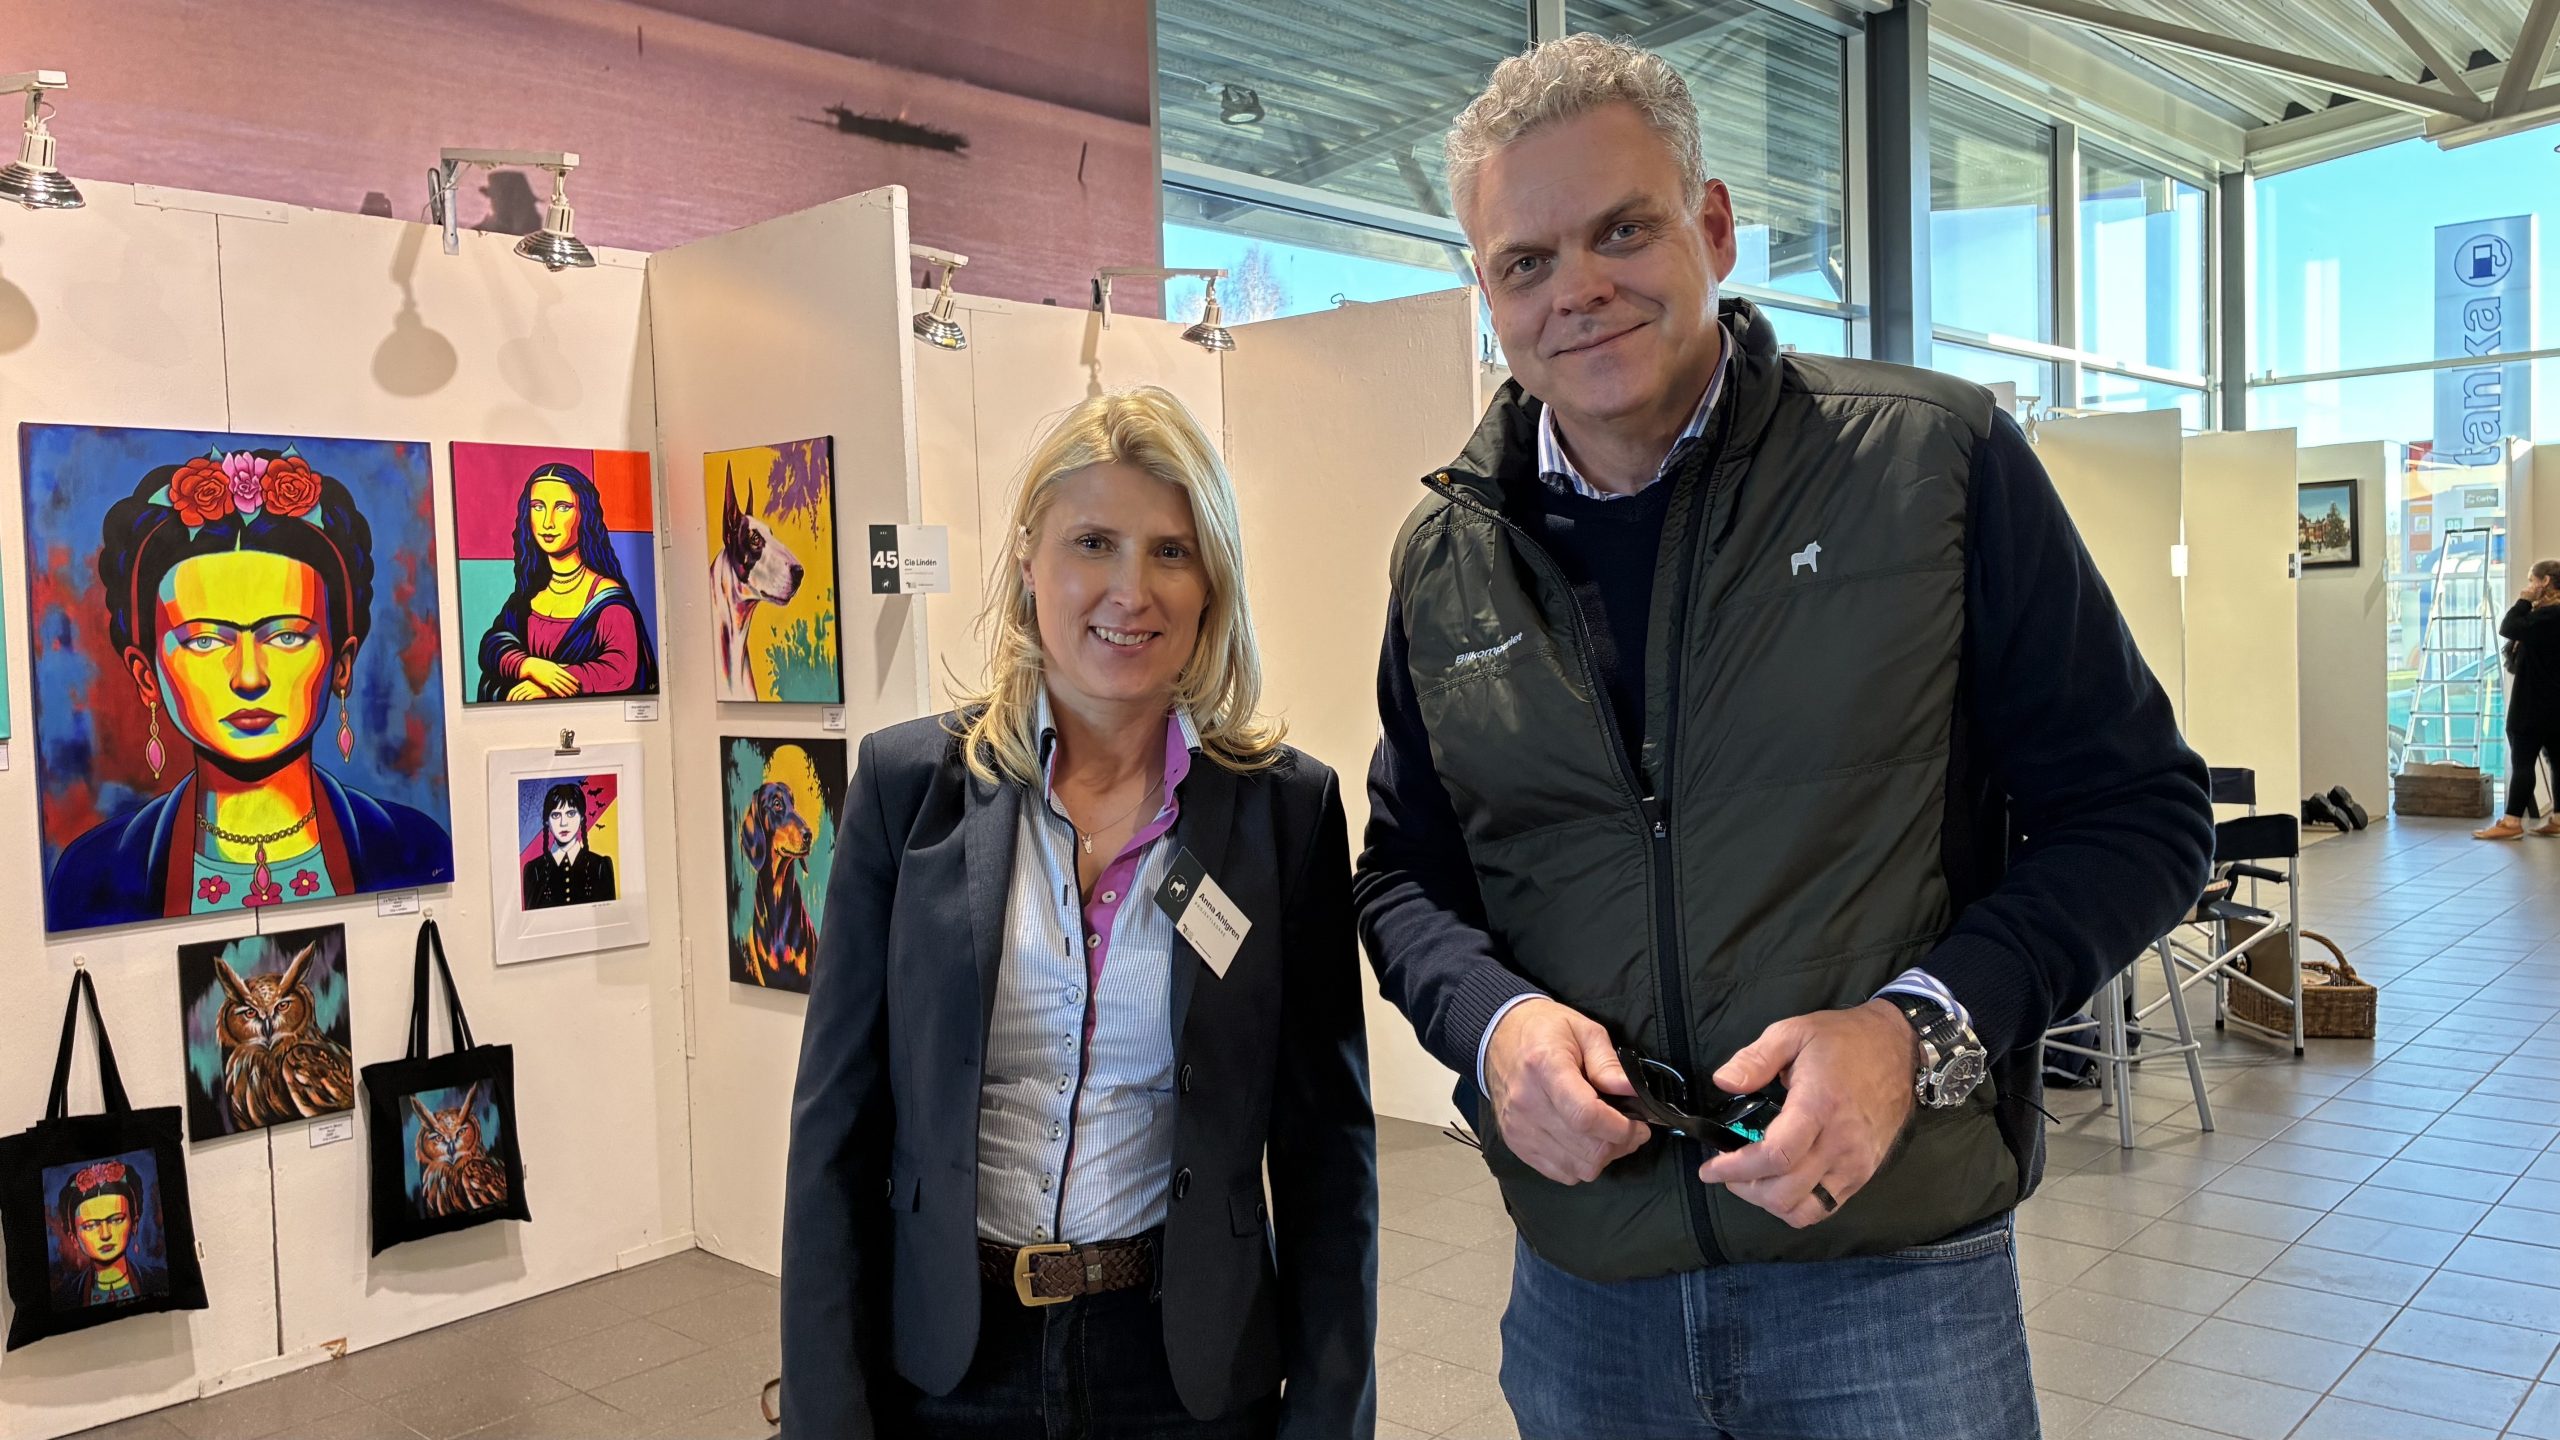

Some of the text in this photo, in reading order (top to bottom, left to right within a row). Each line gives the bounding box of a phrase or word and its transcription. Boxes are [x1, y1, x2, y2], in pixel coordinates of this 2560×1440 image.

[2452, 296, 2501, 467] tanka
[872, 550, 899, 569] 45
[904, 558, 938, 567] Cia Lindén
[1199, 893, 1241, 941] Anna Ahlgren
